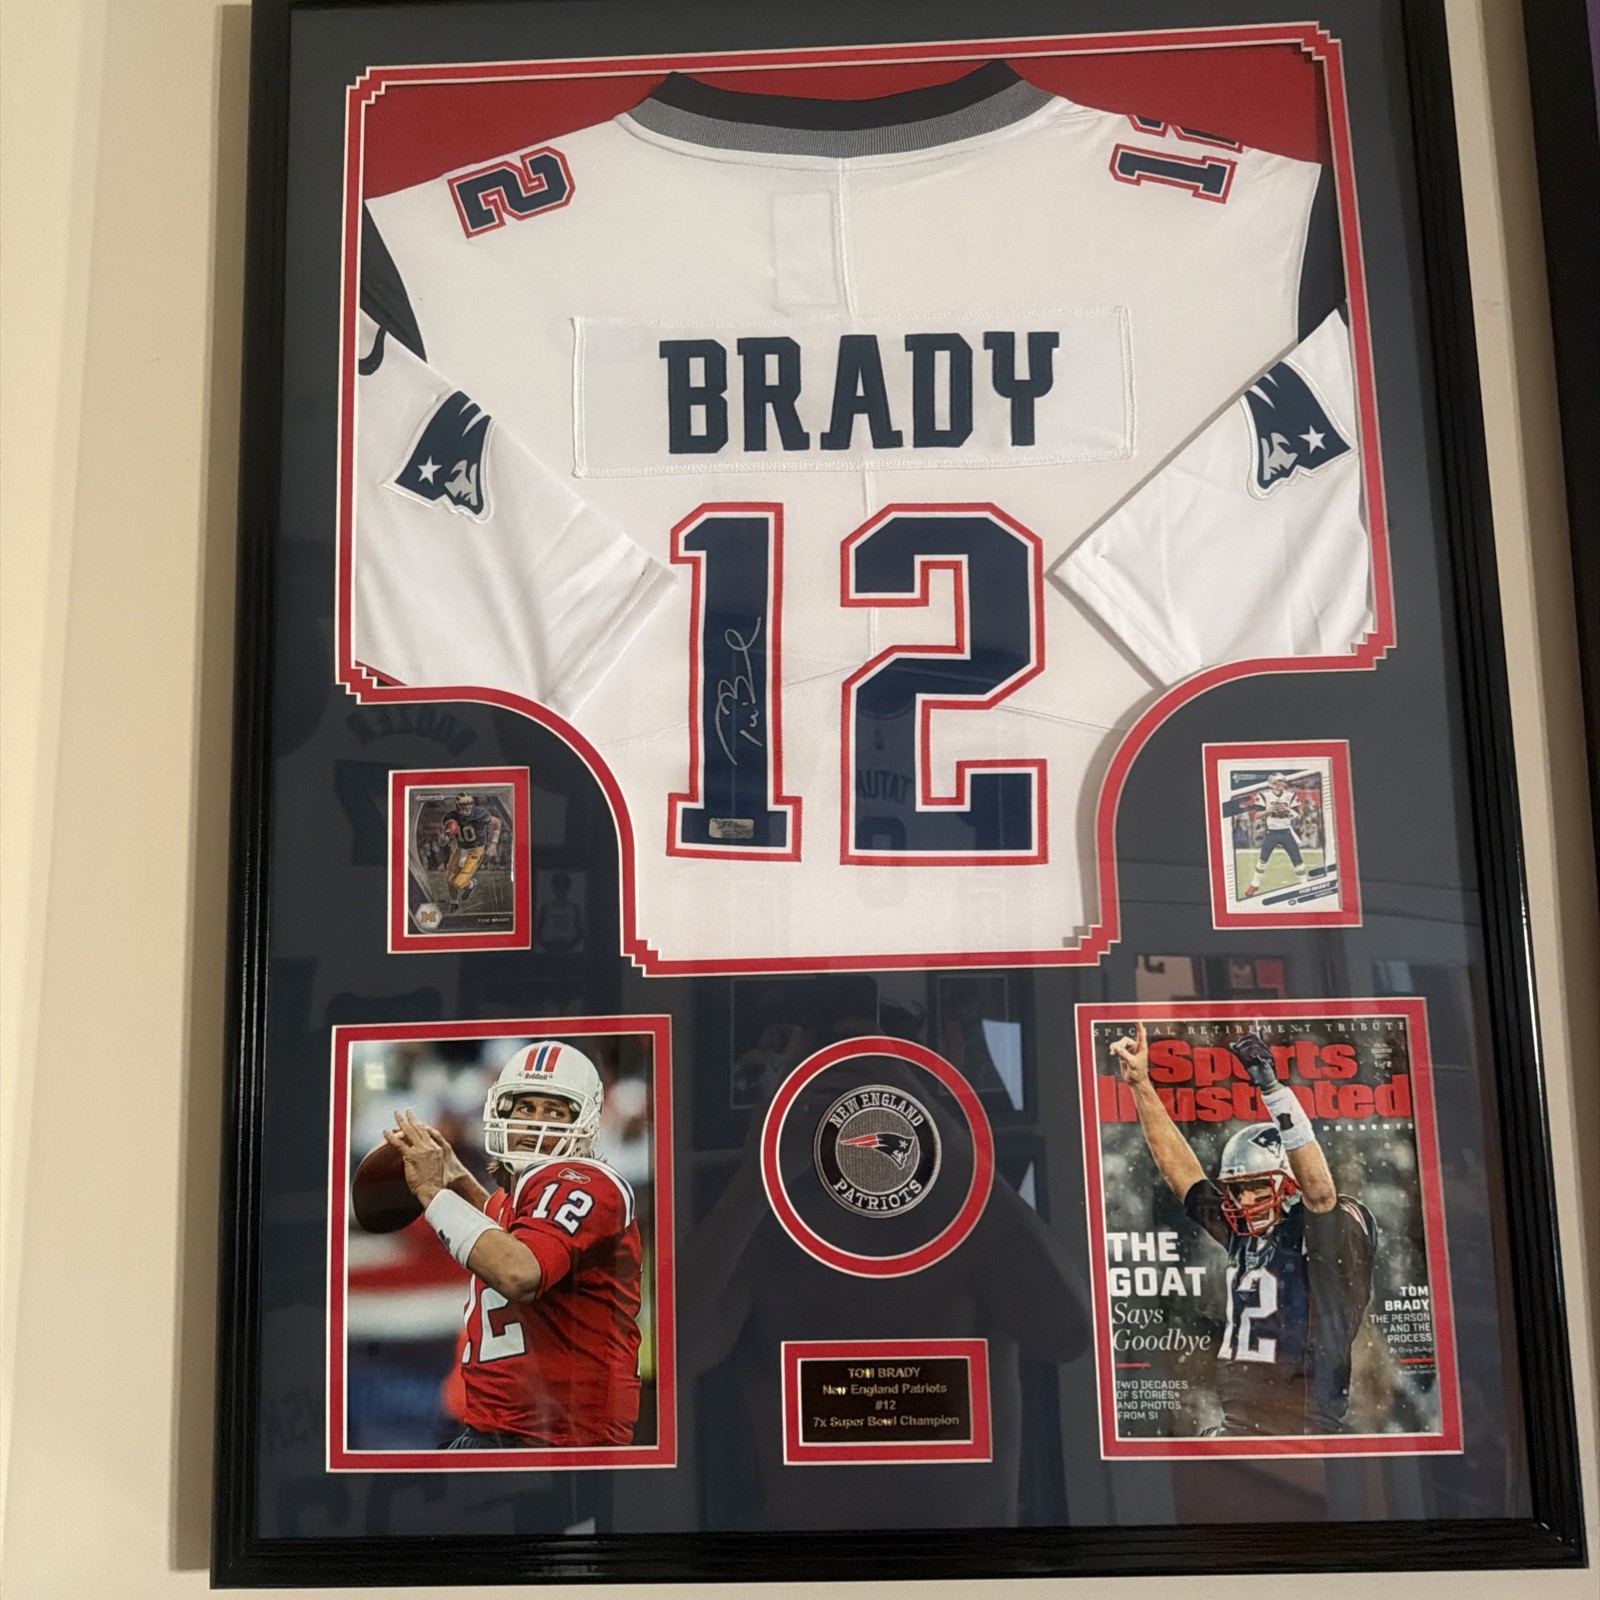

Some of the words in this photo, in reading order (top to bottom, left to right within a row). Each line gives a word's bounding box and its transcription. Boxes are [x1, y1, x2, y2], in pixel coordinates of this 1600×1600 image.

[659, 331, 1060, 454] BRADY
[666, 502, 1048, 865] 12
[1094, 1026, 1177, 1037] SPECAL
[1325, 1022, 1406, 1031] TRIBUTE
[829, 1098, 860, 1128] NEW
[860, 1093, 924, 1127] ENGLAND
[833, 1178, 923, 1210] PATRIOTS
[532, 1183, 594, 1237] 12
[1107, 1232, 1180, 1262] THE
[1109, 1267, 1206, 1297] GOAT
[1399, 1286, 1429, 1297] TOM
[1385, 1300, 1430, 1312] BRADY
[1112, 1302, 1164, 1329] Says
[1369, 1314, 1389, 1324] THE
[1391, 1313, 1431, 1323] PERSON
[1389, 1324, 1410, 1333] AND
[1411, 1323, 1431, 1332] THE
[1113, 1328, 1212, 1356] Goodbye
[1387, 1333, 1433, 1343] PROCESS
[849, 1368, 875, 1379] TOM
[878, 1367, 921, 1378] BRADY
[822, 1384, 847, 1395] New
[851, 1383, 899, 1397] England
[902, 1382, 947, 1394] Patriots
[1116, 1381, 1138, 1390] TWO
[1140, 1380, 1189, 1390] DECADES
[1116, 1391, 1129, 1400] OF
[875, 1399, 897, 1410] #12
[1117, 1401, 1138, 1410] AND
[1140, 1400, 1182, 1410] PHOTOS
[813, 1416, 827, 1428] 7x
[830, 1415, 864, 1429] Super
[868, 1415, 897, 1427] Bowl
[900, 1413, 960, 1427] Champion
[1118, 1411, 1145, 1420] FROM
